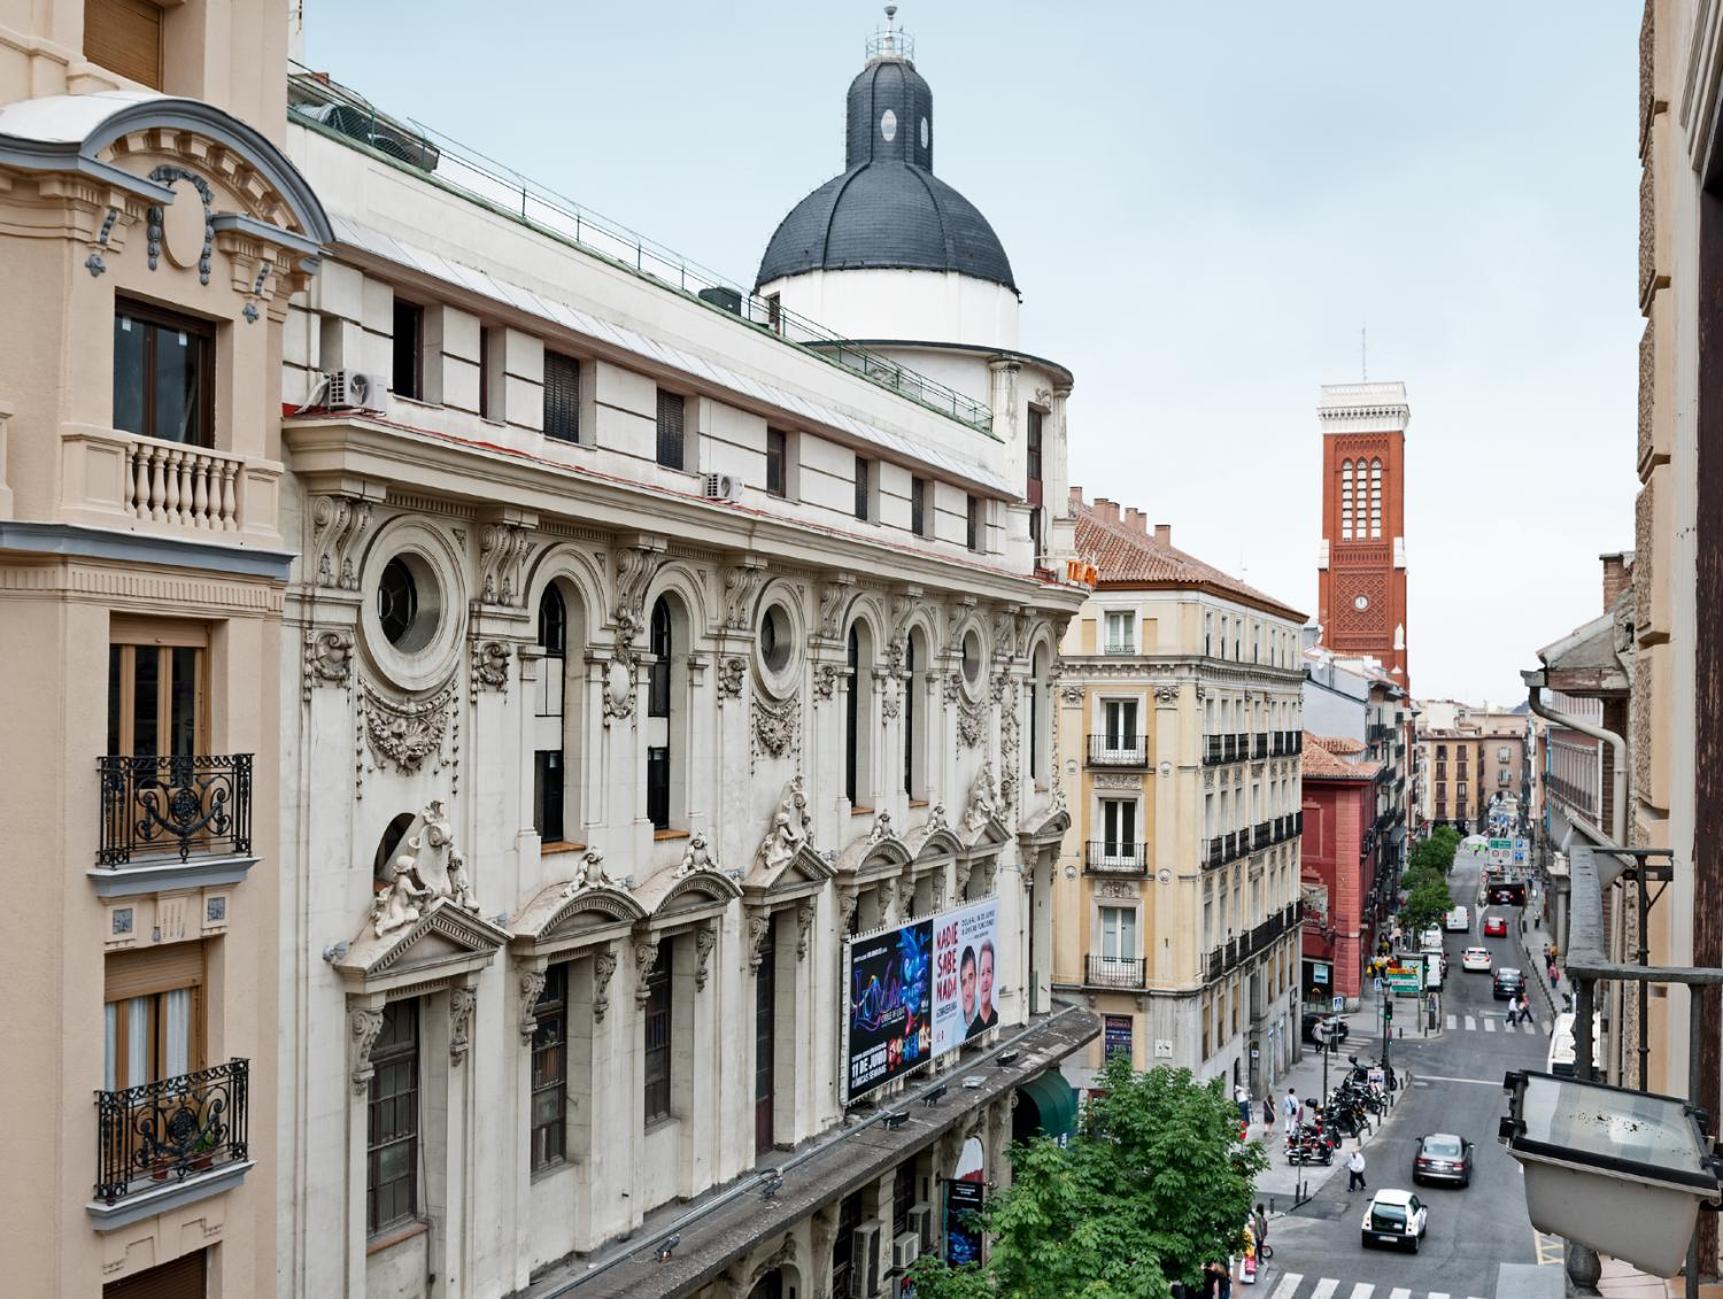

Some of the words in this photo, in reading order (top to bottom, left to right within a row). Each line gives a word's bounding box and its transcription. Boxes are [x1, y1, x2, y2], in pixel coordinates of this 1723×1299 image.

[937, 921, 958, 949] NADIE
[937, 948, 957, 978] SABE
[936, 975, 957, 1002] NADA
